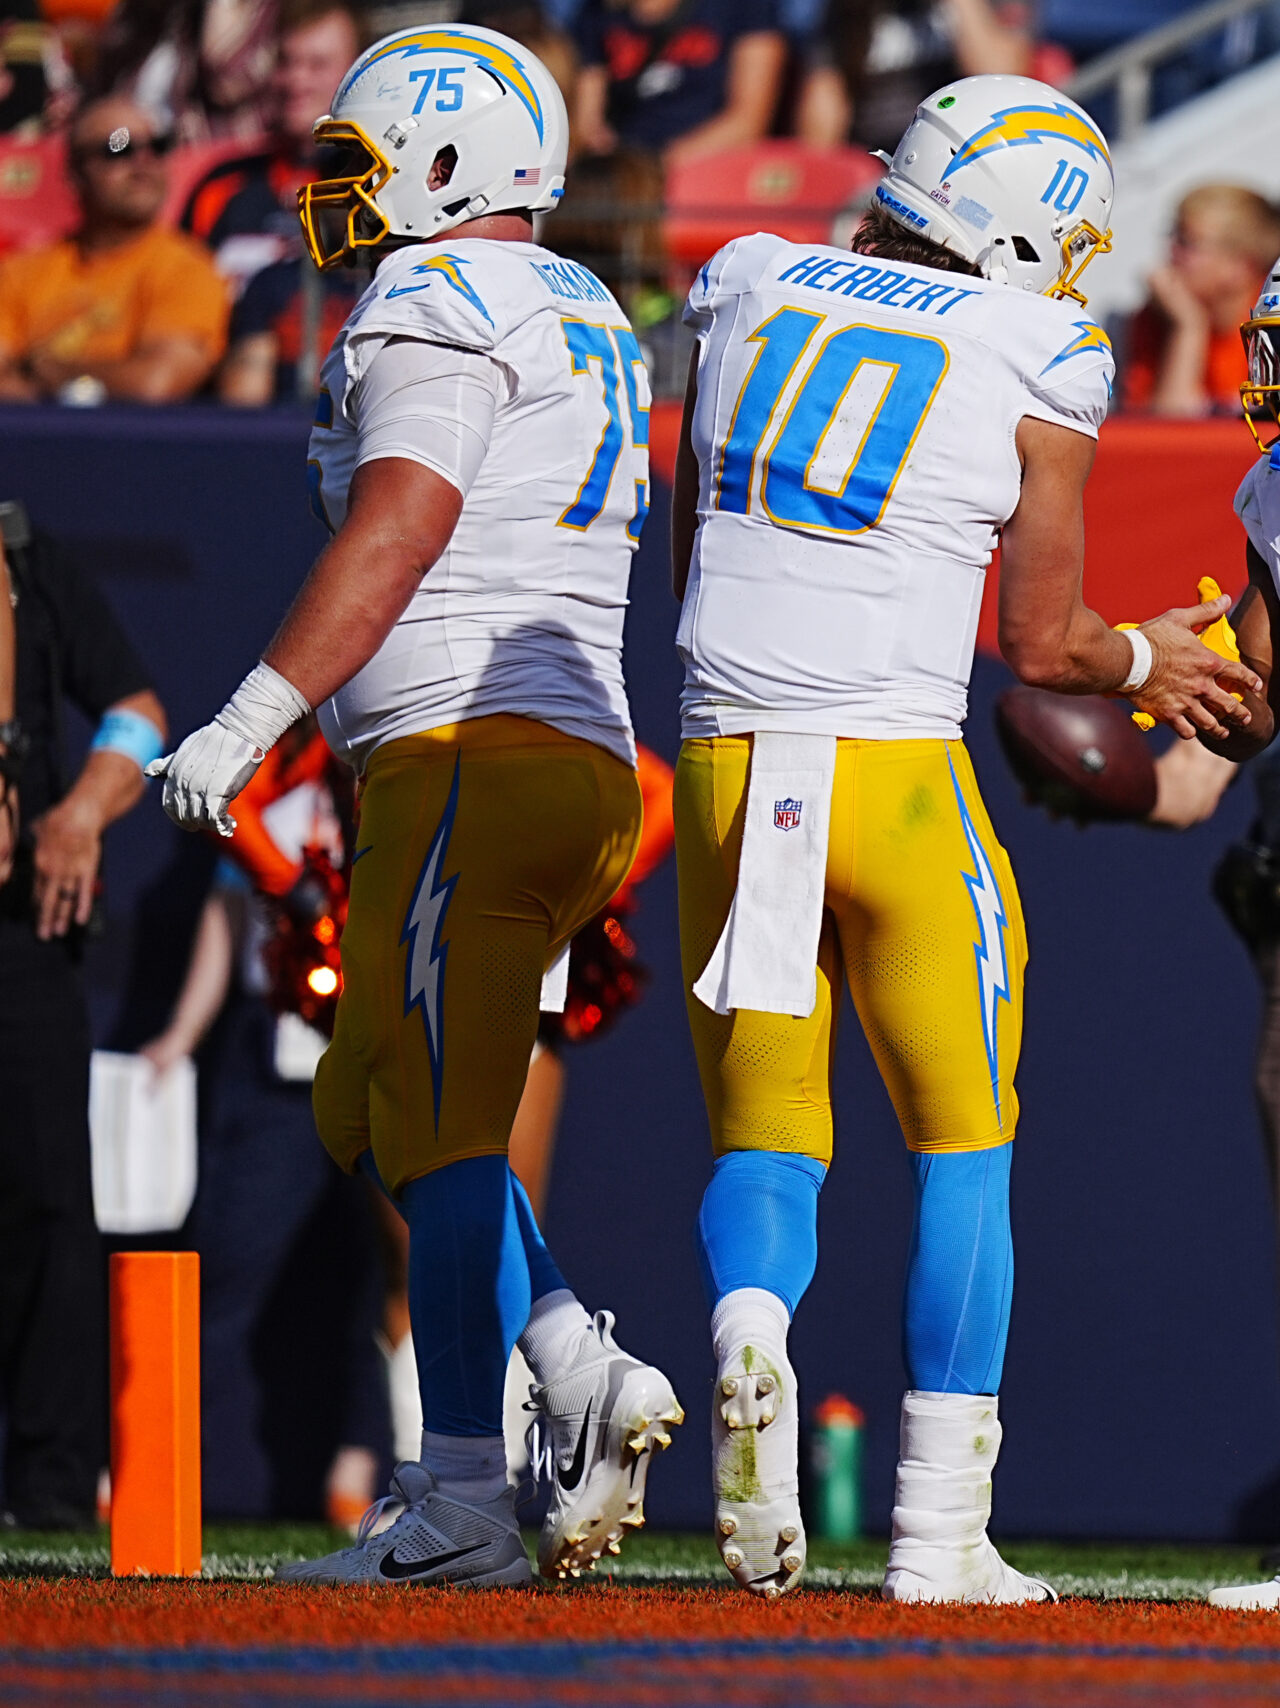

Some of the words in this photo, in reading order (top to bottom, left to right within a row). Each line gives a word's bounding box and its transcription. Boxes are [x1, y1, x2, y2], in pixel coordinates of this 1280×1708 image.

[409, 67, 466, 115] 75
[1040, 159, 1089, 215] 10
[777, 256, 984, 315] HERBERT
[715, 305, 950, 535] 10
[775, 811, 799, 828] NFL
